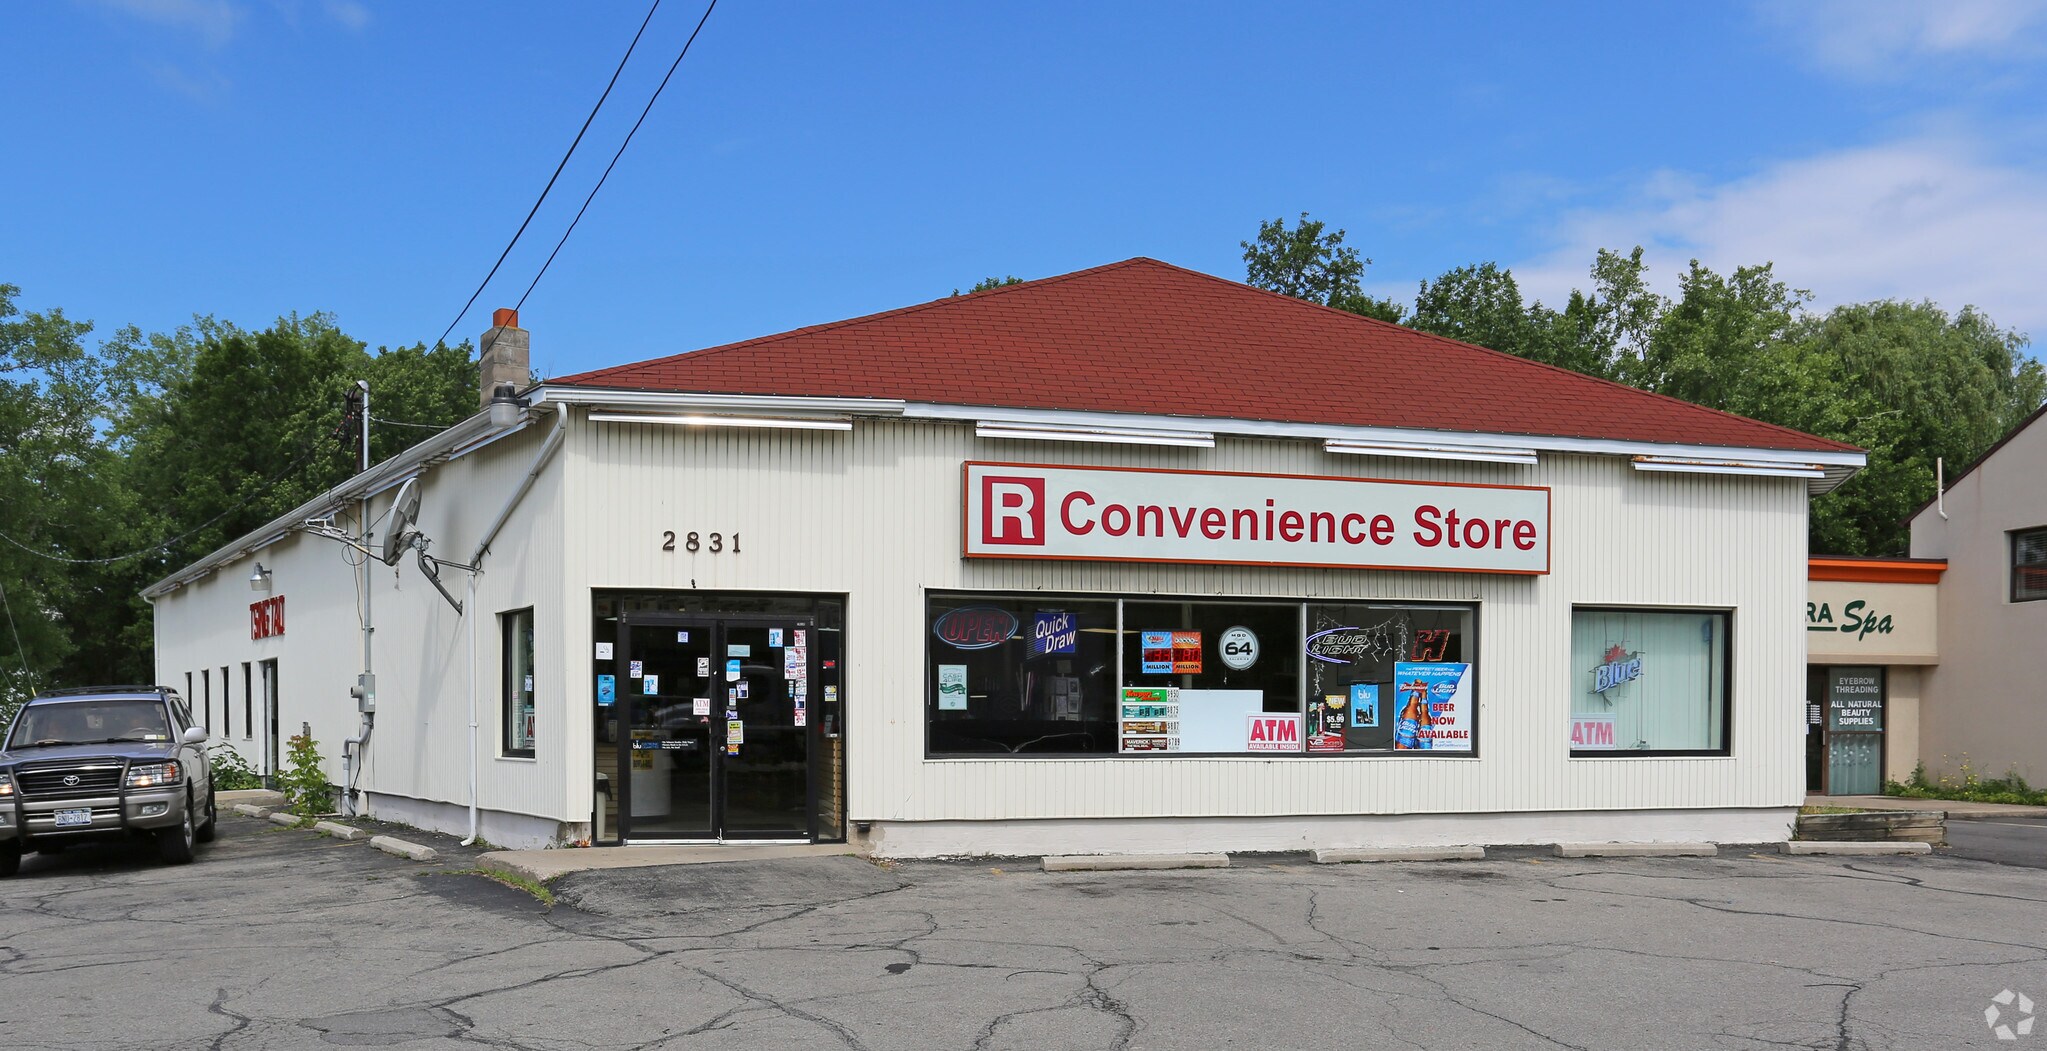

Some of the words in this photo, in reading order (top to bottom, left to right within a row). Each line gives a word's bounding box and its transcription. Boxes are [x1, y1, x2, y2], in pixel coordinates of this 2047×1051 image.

[1060, 490, 1395, 546] Convenience
[1412, 504, 1538, 551] Store
[663, 530, 741, 553] 2831
[944, 612, 1008, 643] OPEN
[1035, 612, 1069, 639] Quick
[1840, 600, 1894, 642] Spa
[1045, 631, 1076, 654] Draw
[1225, 641, 1253, 656] 64
[1310, 643, 1369, 655] LIGHT
[1322, 634, 1369, 645] BUD
[1594, 658, 1641, 693] Blue
[1358, 690, 1371, 699] blu
[1326, 714, 1345, 723] $5.99
[1431, 717, 1455, 725] NOW
[1250, 719, 1297, 741] ATM
[1418, 730, 1469, 739] AVAILABLE
[1571, 721, 1613, 745] ATM
